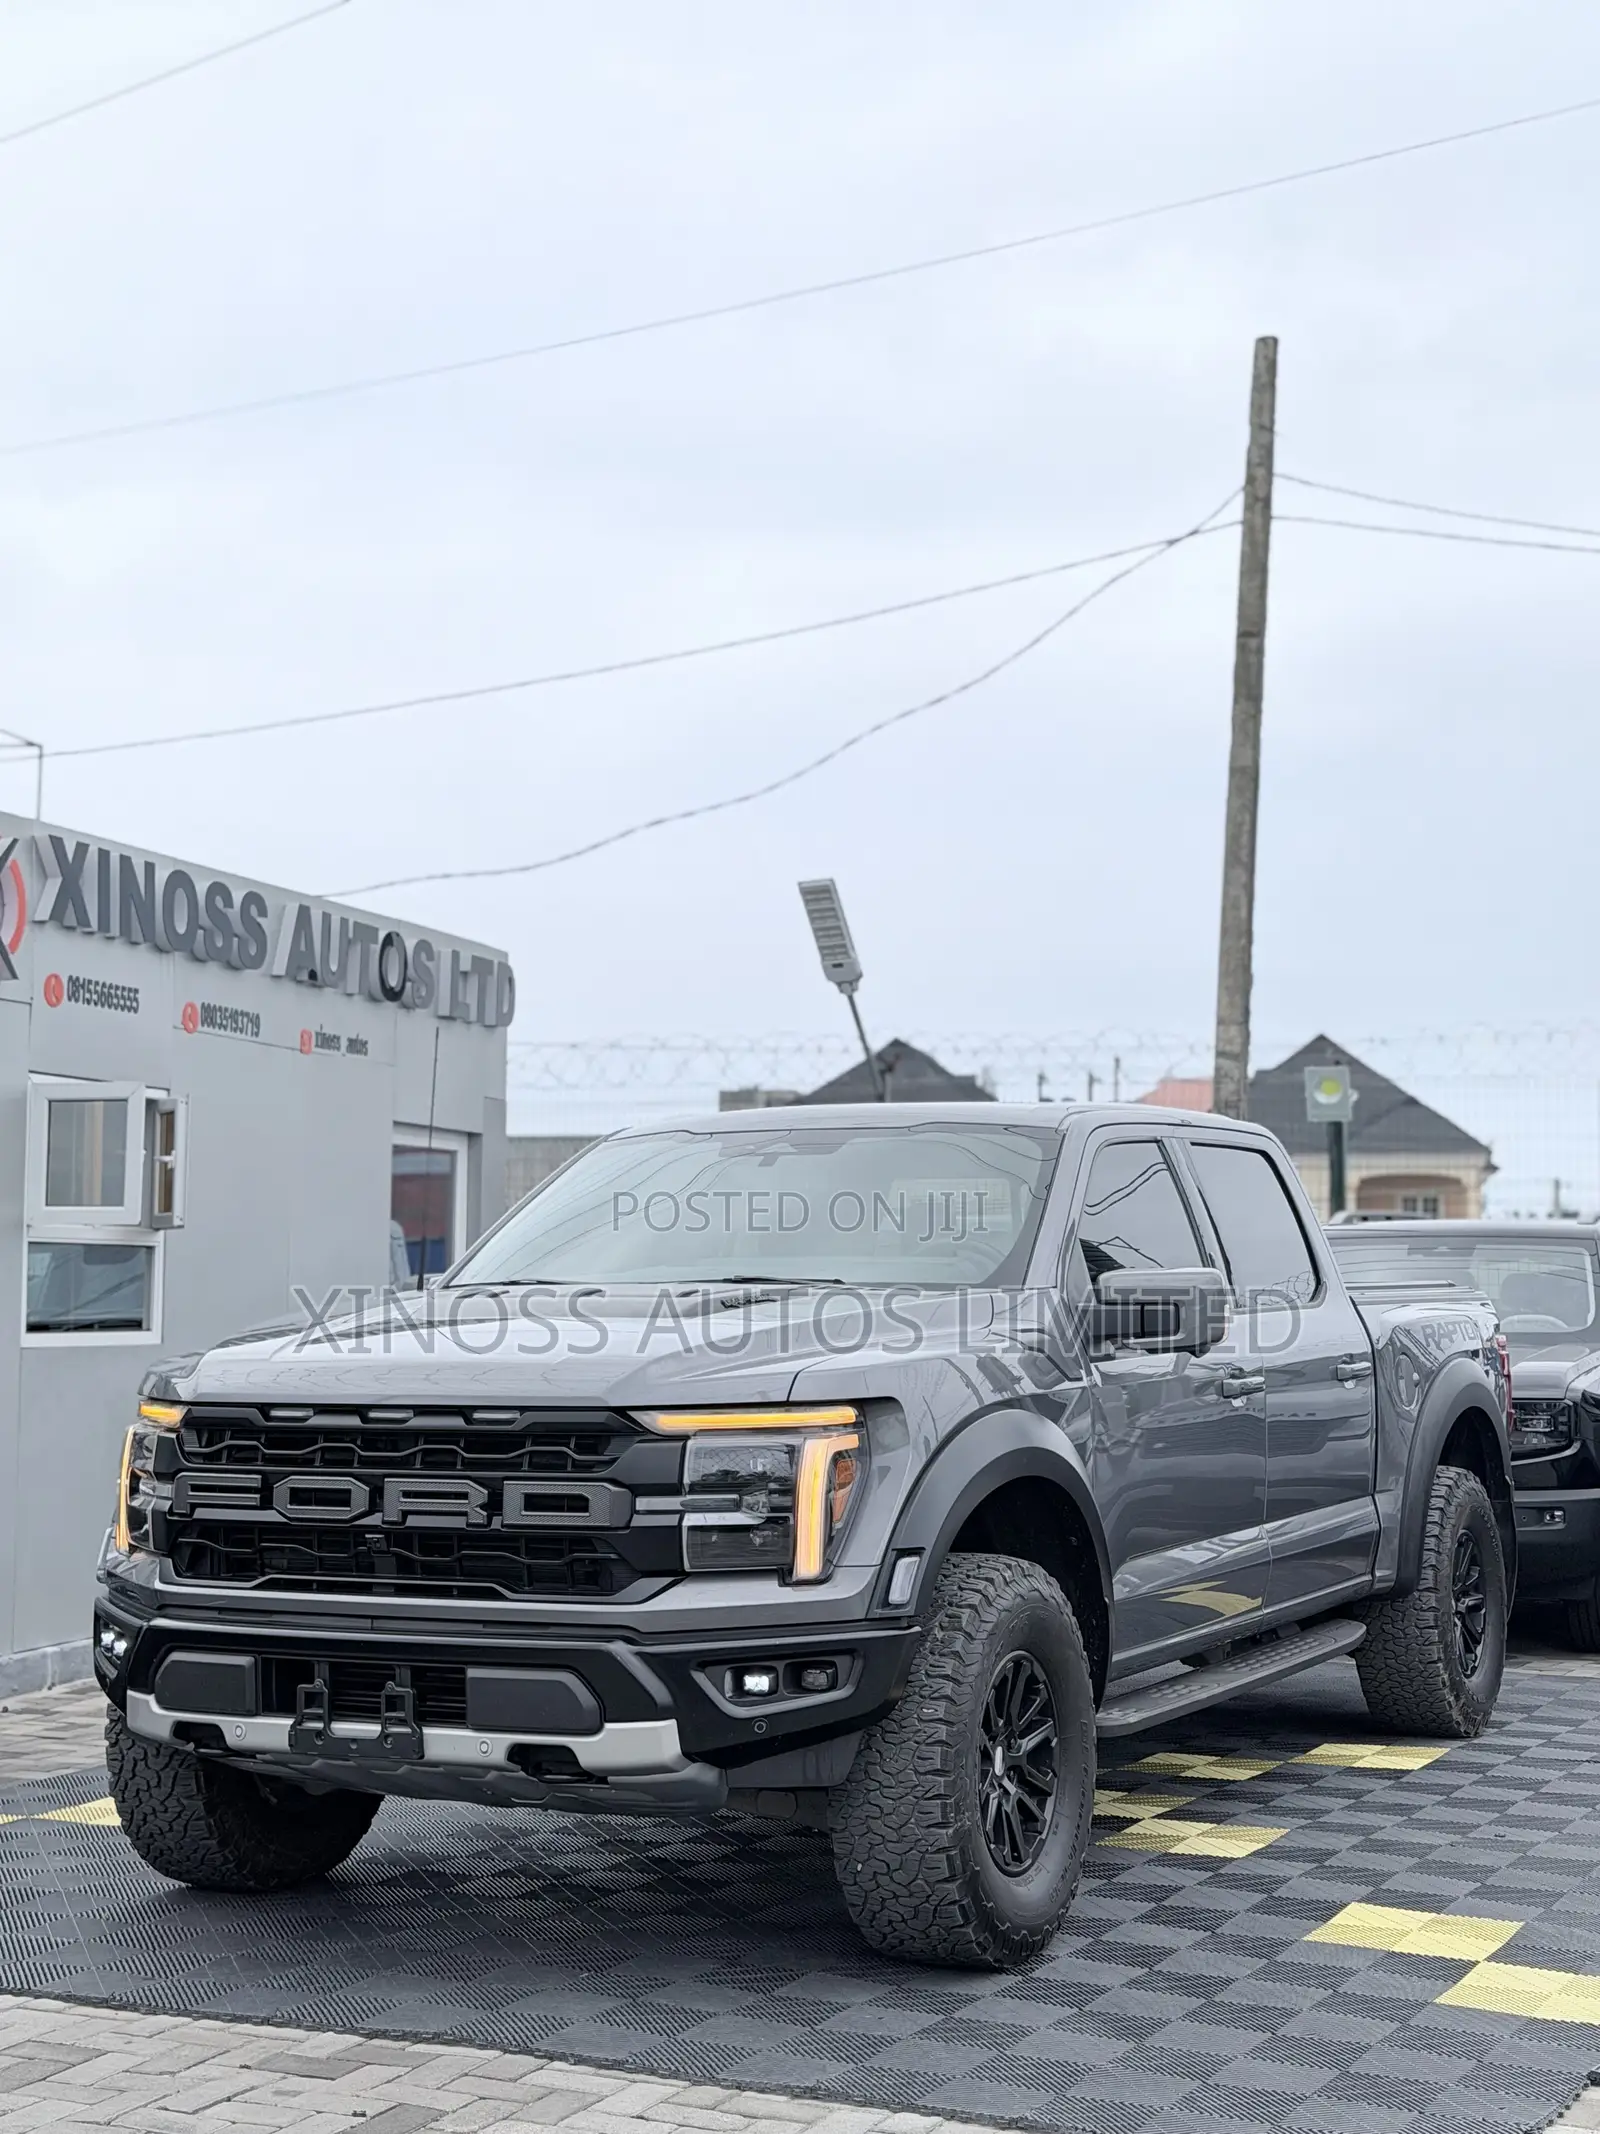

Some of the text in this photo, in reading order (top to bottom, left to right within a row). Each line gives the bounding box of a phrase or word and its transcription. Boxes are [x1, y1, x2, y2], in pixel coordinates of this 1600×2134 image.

[36, 834, 516, 1028] XINOSS AUTOS LTD
[66, 974, 140, 1014] 08155665555
[200, 1001, 262, 1038] 08035193719
[173, 1471, 633, 1528] FORD
